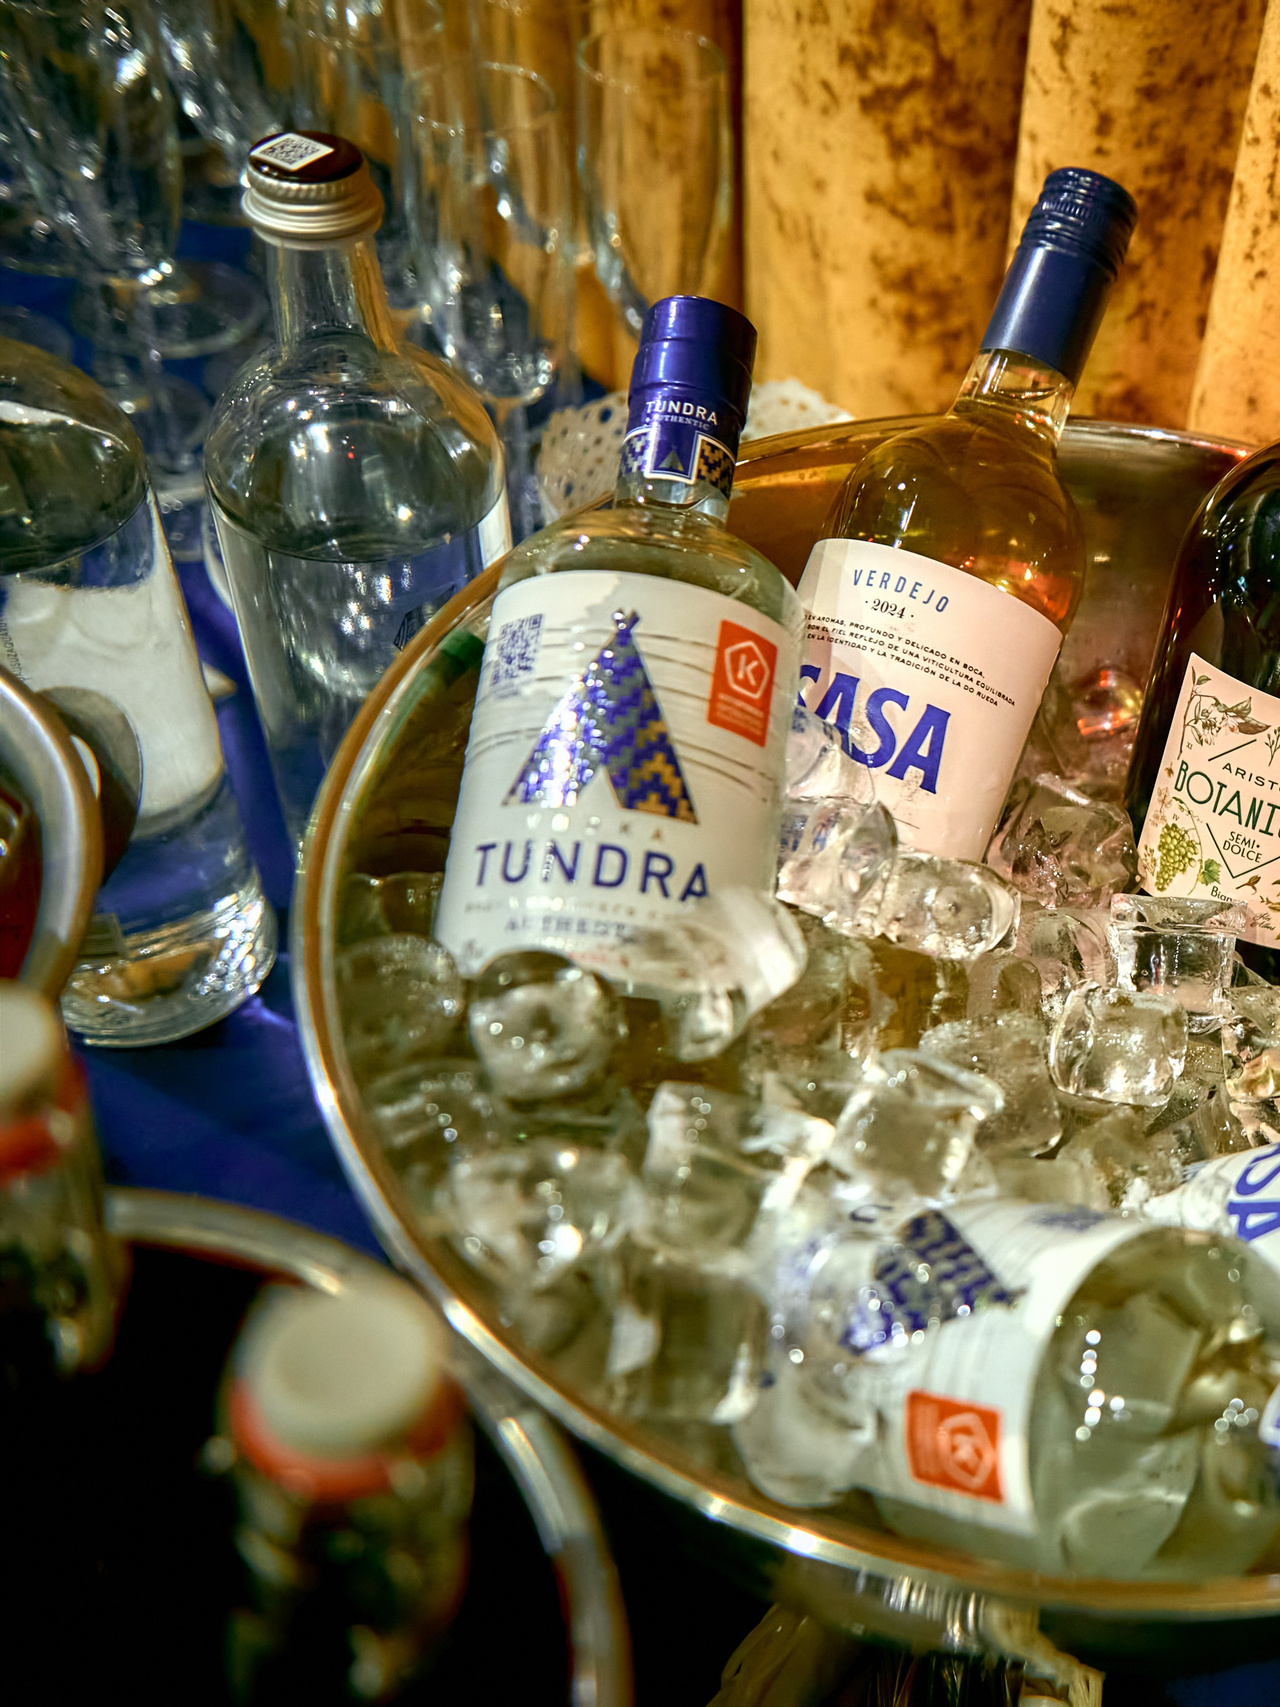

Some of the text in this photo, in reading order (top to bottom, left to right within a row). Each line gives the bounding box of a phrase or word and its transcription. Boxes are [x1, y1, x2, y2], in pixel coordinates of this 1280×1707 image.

[645, 399, 718, 426] TUNDRA
[853, 569, 950, 613] VERDEJO
[870, 598, 906, 619] 2024
[826, 636, 867, 651] IDENTIDAD
[877, 650, 887, 658] LA
[890, 654, 936, 676] TRADICIÓN
[938, 673, 950, 683] DE
[951, 680, 962, 688] LA
[963, 684, 975, 694] DO
[976, 690, 998, 707] RUEDA
[831, 628, 846, 636] FIEL
[849, 631, 885, 647] REFLEJO
[887, 643, 900, 652] DE
[902, 648, 920, 660] UNA
[922, 656, 974, 683] VITICULTURA
[975, 680, 1016, 707] EQUILIBRADA
[849, 621, 895, 640] PROFUNDO
[904, 639, 947, 660] DELICADO
[949, 656, 961, 666] EN
[962, 662, 985, 679] BOCA,
[475, 839, 709, 903] TUNDRA
[1222, 840, 1263, 863] DOLCE
